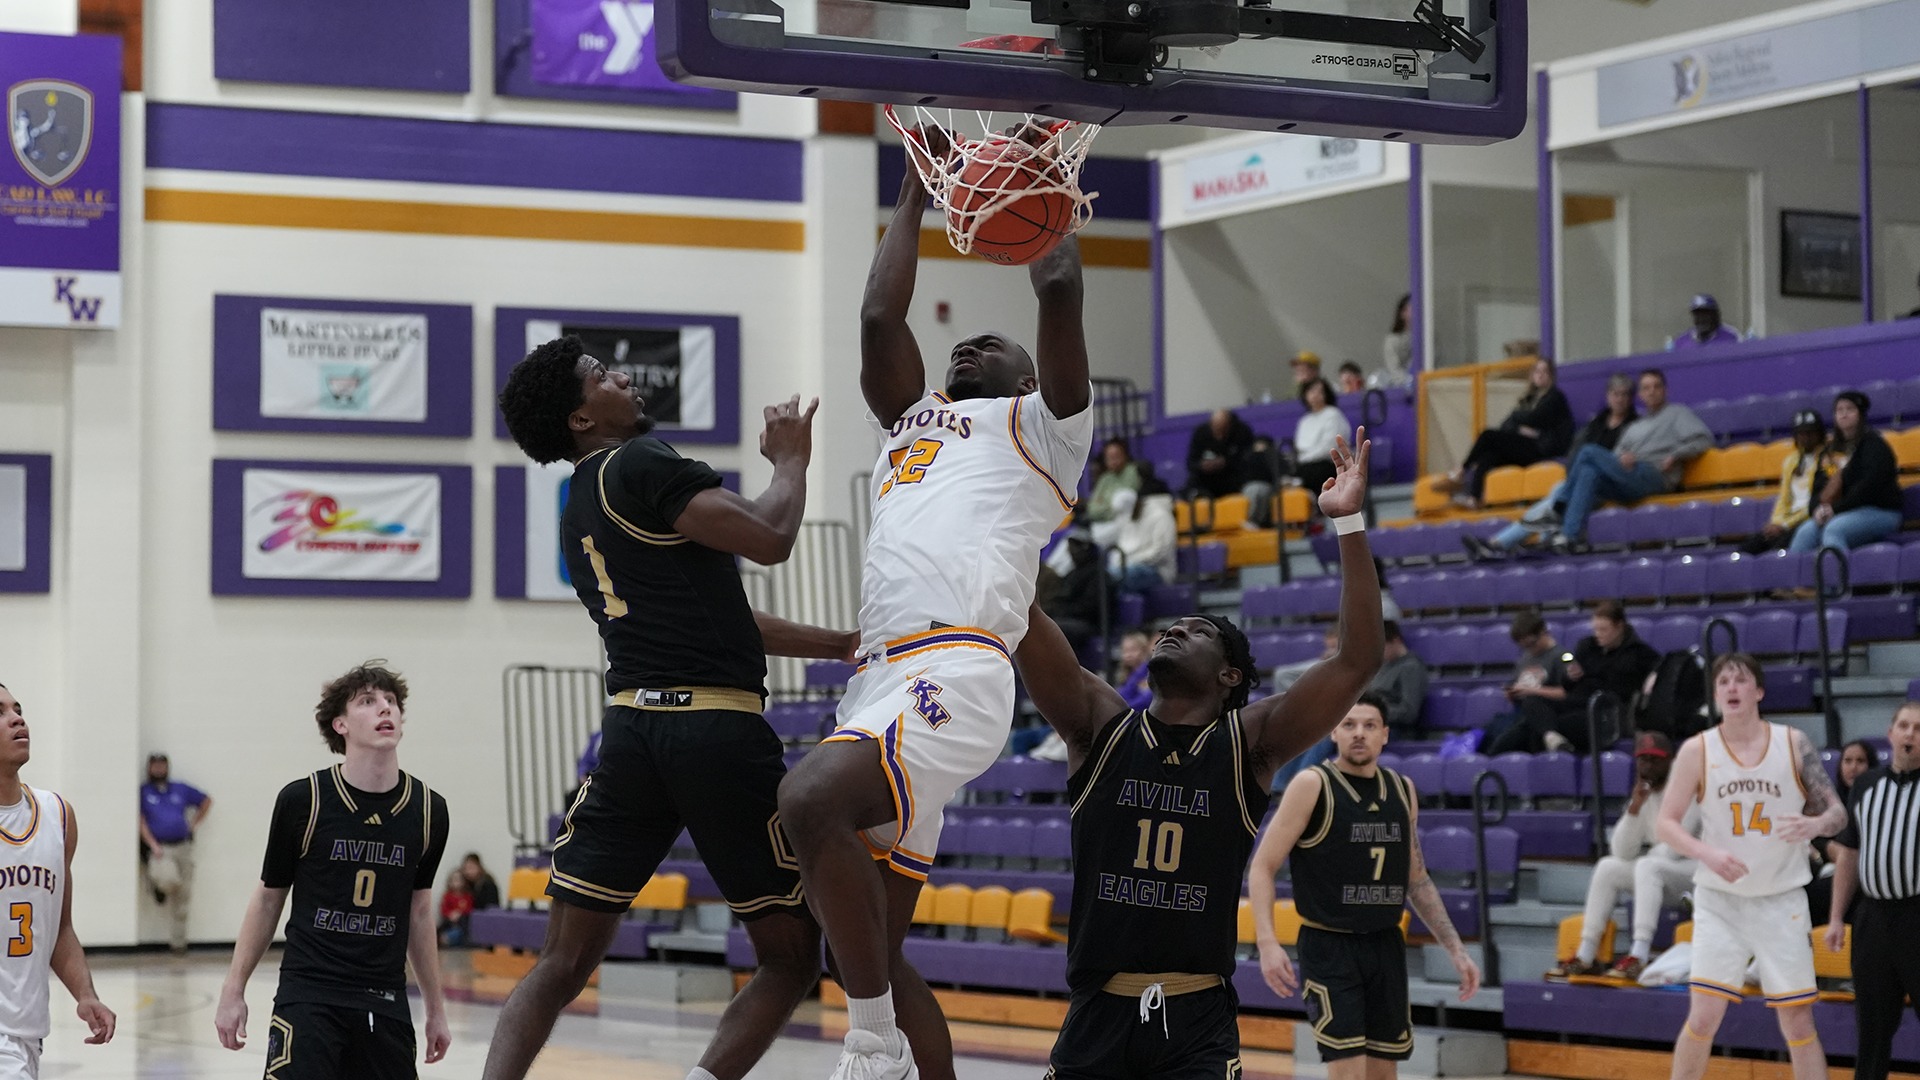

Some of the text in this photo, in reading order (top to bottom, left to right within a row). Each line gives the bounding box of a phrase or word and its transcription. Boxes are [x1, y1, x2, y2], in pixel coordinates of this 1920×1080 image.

[578, 33, 608, 51] the
[54, 276, 102, 320] KW
[890, 409, 971, 439] OYOTES
[581, 535, 628, 621] 1
[907, 677, 952, 731] KW
[1117, 779, 1210, 818] AVILA
[1718, 779, 1782, 798] COYOTES
[1350, 823, 1402, 842] AVILA
[1730, 802, 1772, 836] 14
[330, 839, 405, 867] AVILA
[1133, 818, 1184, 873] 10
[0, 864, 56, 895] OYOTES
[1370, 847, 1386, 881] 7
[352, 869, 377, 908] 0
[1097, 872, 1208, 912] EAGLES
[1342, 885, 1404, 905] EAGLES
[7, 901, 34, 957] 3
[313, 907, 397, 936] EAGLES
